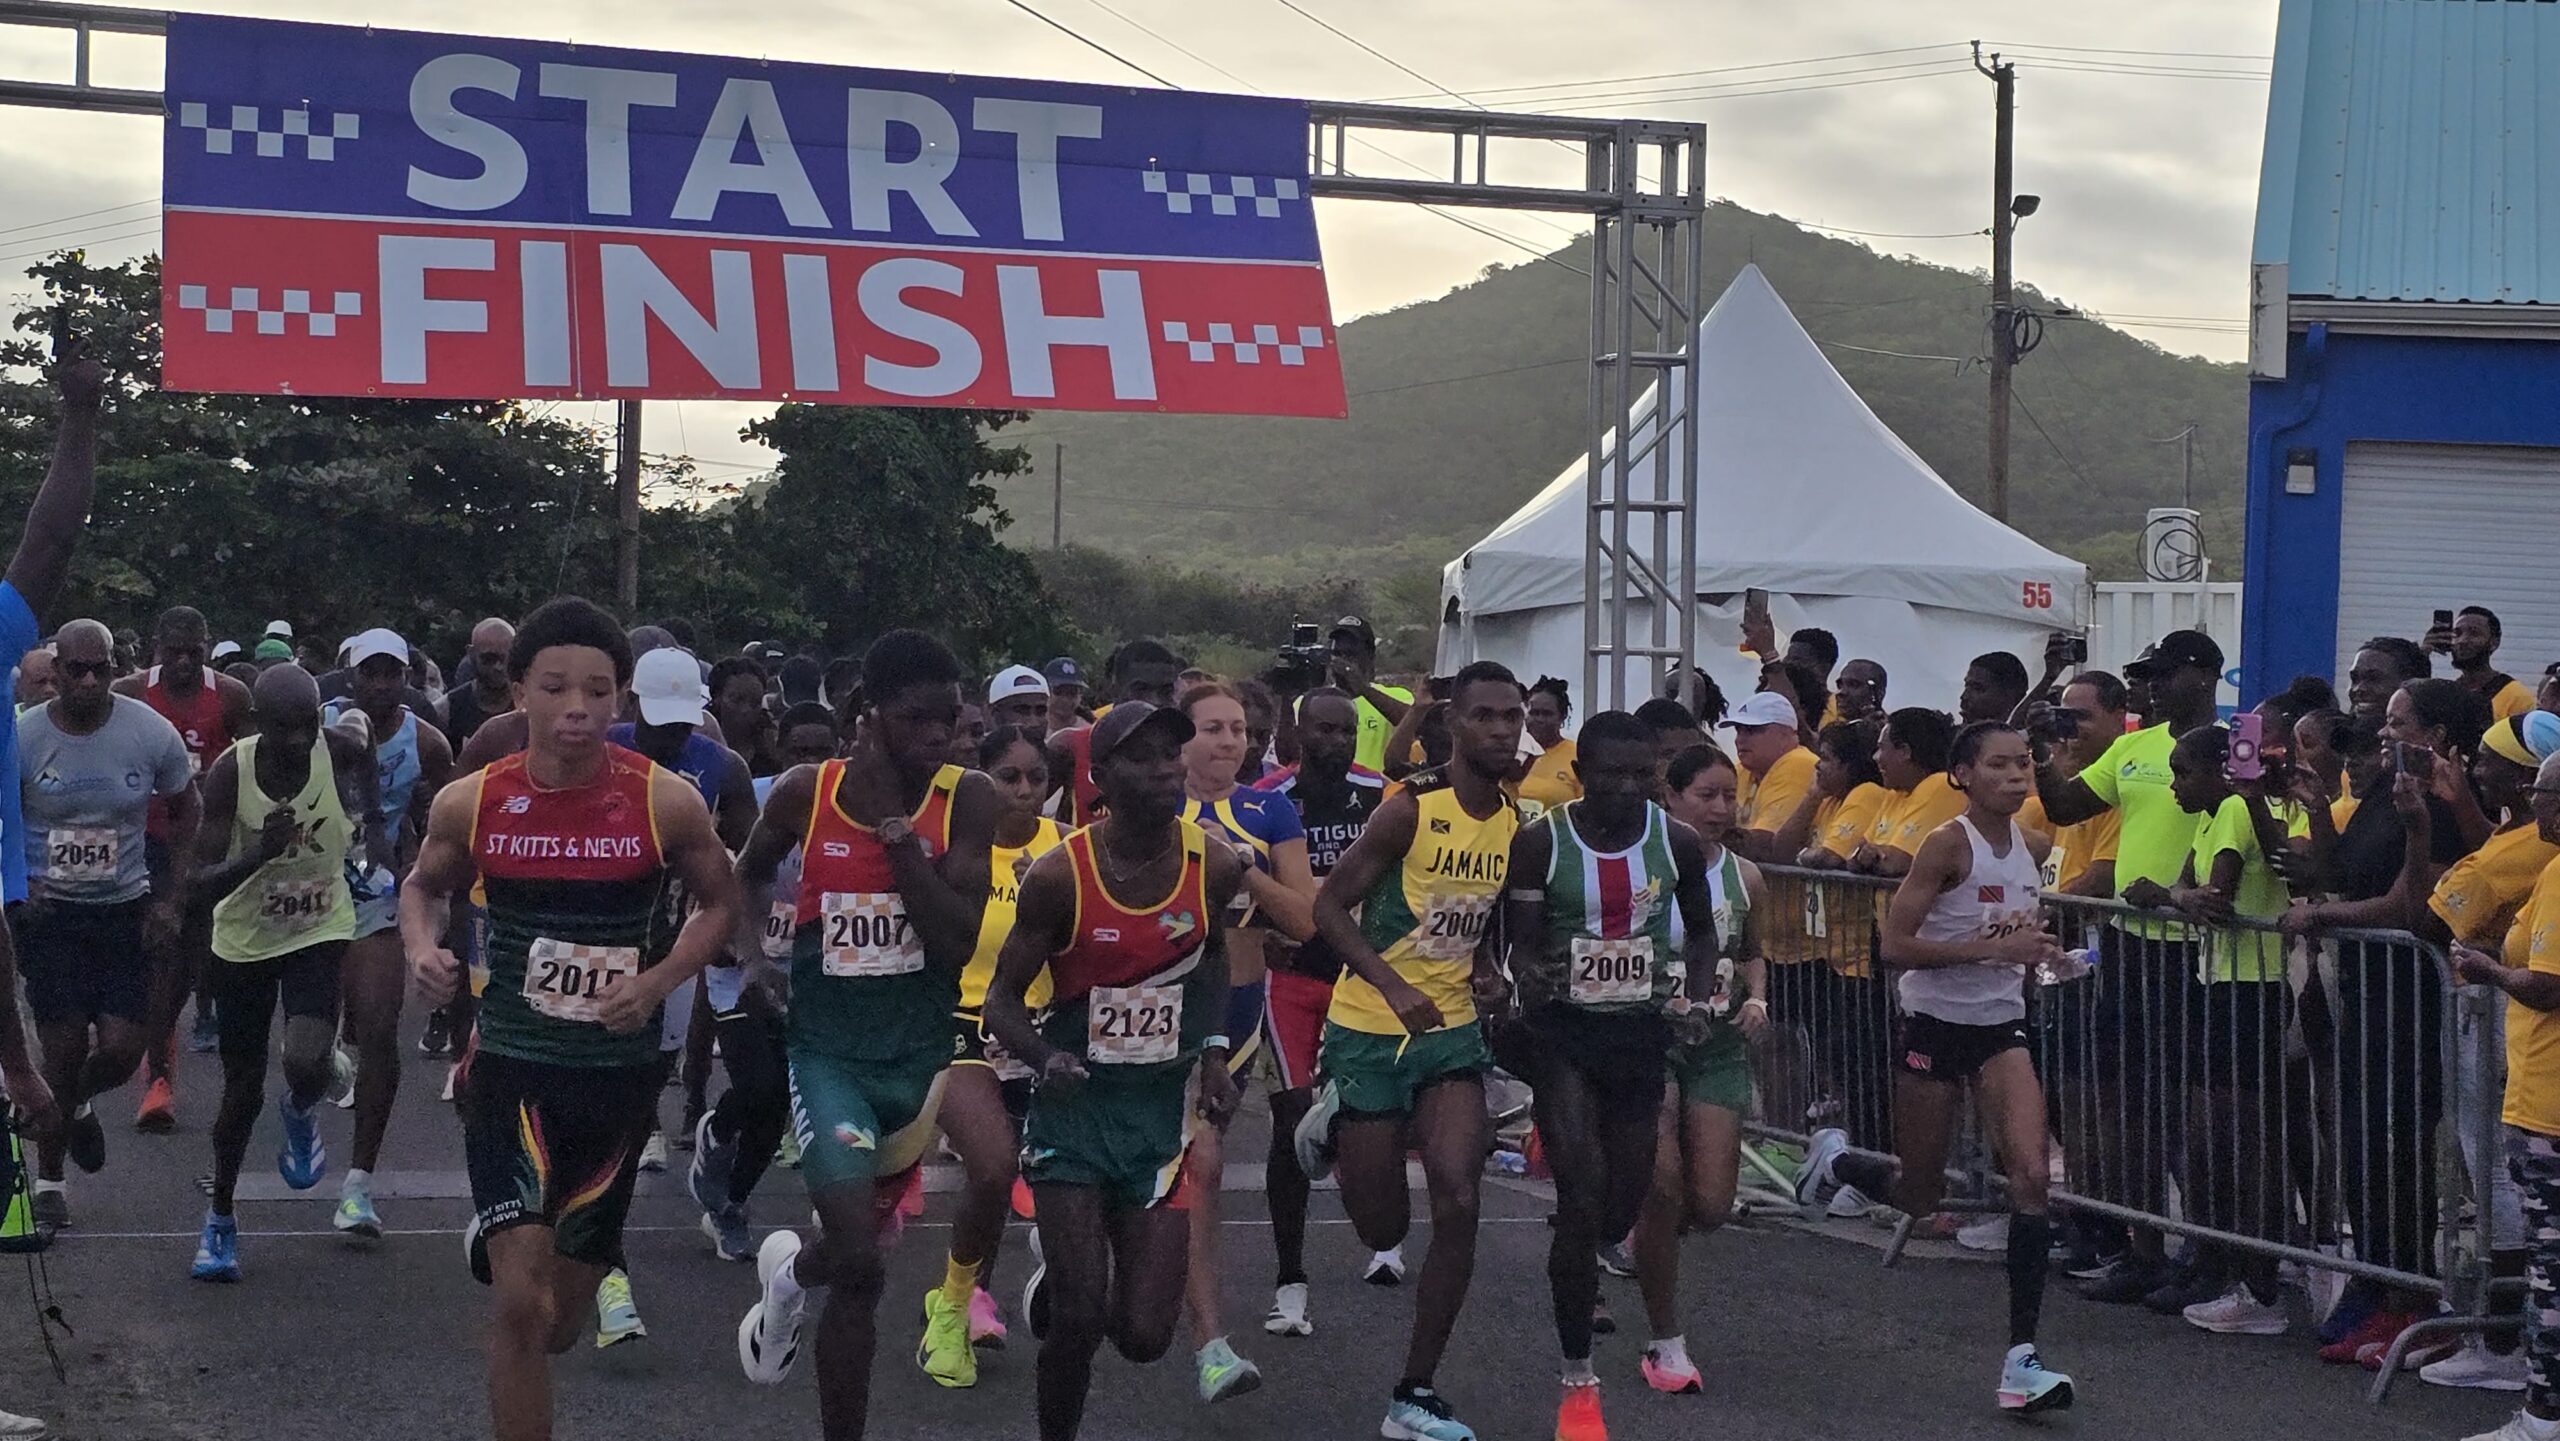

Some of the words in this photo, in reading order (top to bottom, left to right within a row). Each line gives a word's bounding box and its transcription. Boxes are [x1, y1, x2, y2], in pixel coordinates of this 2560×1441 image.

[406, 53, 1103, 242] START
[377, 234, 1159, 400] FINISH
[2022, 581, 2052, 609] 55
[54, 844, 111, 867] 2054
[486, 833, 508, 855] ST
[510, 835, 561, 858] KITTS
[565, 836, 579, 857] &
[584, 836, 642, 858] NEVIS
[264, 891, 327, 917] 2041
[832, 914, 908, 948] 2007
[1430, 911, 1486, 937] 2001
[1580, 955, 1645, 982] 2009
[1100, 1005, 1174, 1037] 2123
